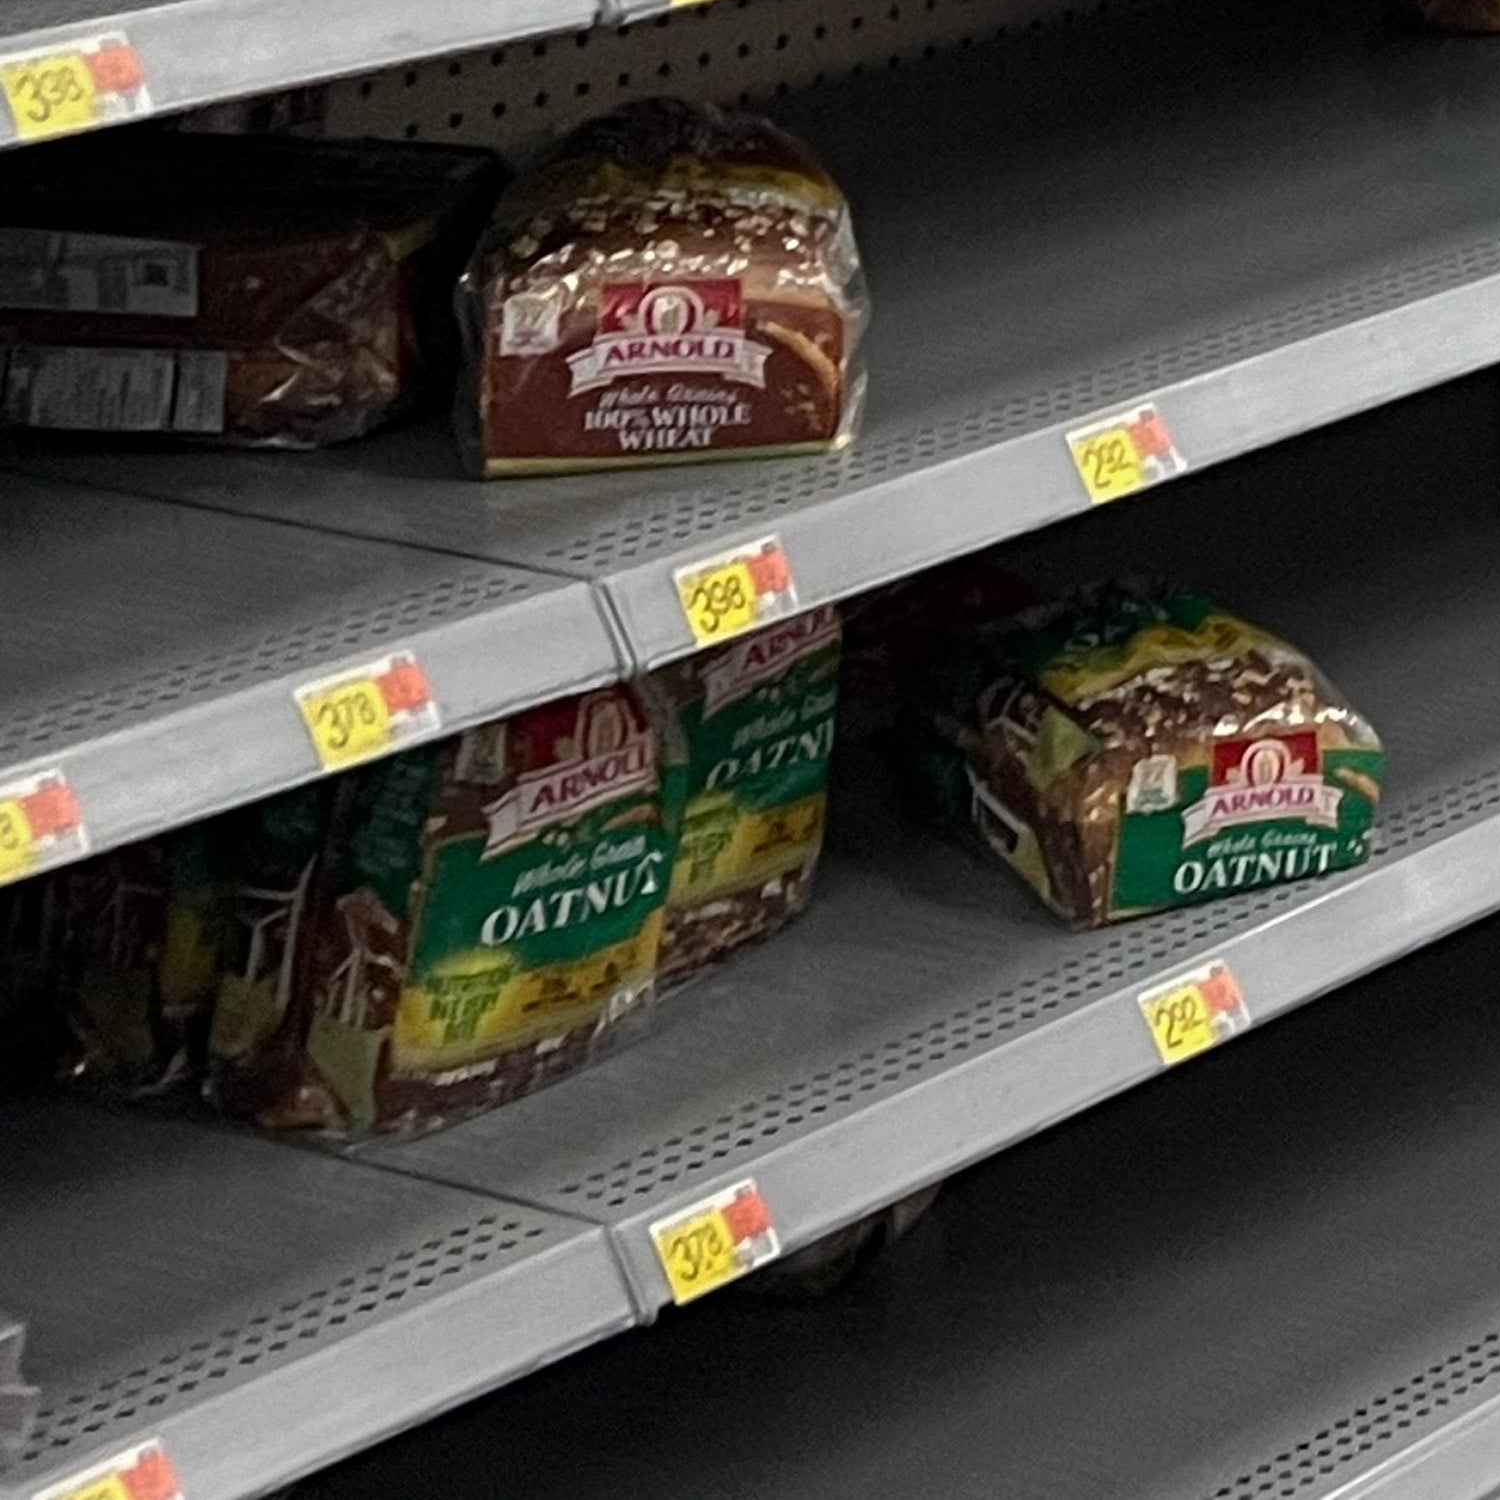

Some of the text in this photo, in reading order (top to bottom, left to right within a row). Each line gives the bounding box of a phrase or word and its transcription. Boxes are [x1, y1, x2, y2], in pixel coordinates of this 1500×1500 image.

[603, 339, 736, 364] ARNOLD
[584, 402, 752, 432] 100% WHOLE
[617, 426, 716, 451] WHEAT
[318, 692, 375, 749] 378
[1210, 787, 1315, 817] ARNOLD
[1173, 841, 1337, 894] OATNUT
[479, 851, 666, 948] OATNUT
